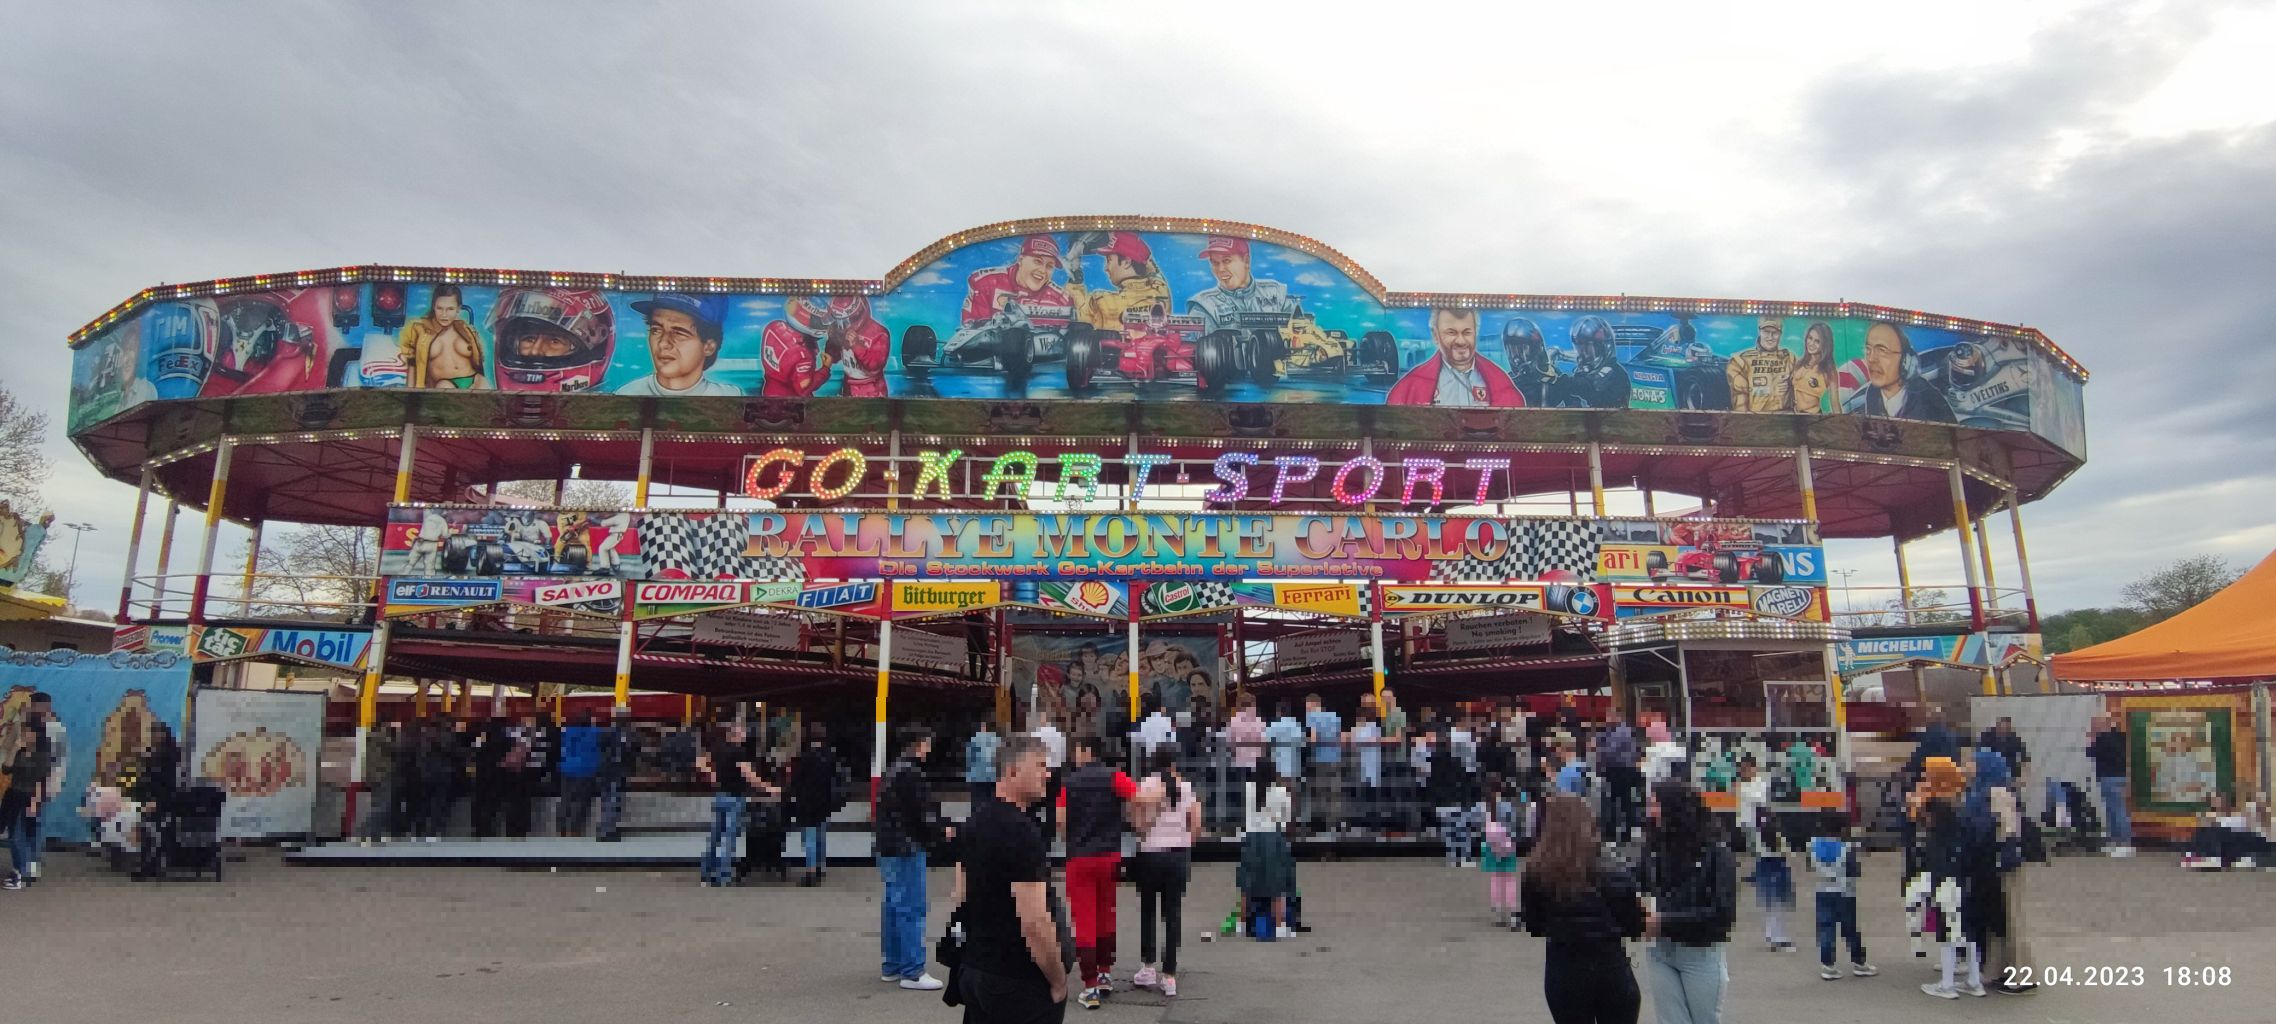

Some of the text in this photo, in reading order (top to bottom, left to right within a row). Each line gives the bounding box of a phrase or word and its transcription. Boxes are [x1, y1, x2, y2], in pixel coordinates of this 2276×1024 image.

[159, 355, 199, 370] FedEx
[1204, 452, 1511, 506] SPORT
[742, 513, 1510, 562] RALLYE MONTE CARLO
[878, 560, 1384, 578] Die Stockwerk Go-Kartbahn der Superlative
[395, 585, 496, 597] elf RENAULT
[542, 582, 613, 602] SANYO
[640, 585, 737, 601] COMPAQ
[768, 585, 799, 597] DEKRA
[801, 585, 870, 607] FIAT
[903, 585, 986, 608] Bitburger
[1164, 586, 1190, 603] Castrol
[1281, 586, 1352, 605] Ferrari
[1409, 593, 1540, 605] DUNLOP
[1633, 586, 1731, 605] Canon
[271, 630, 354, 662] Mobil
[1858, 640, 1934, 653] MICHELIN
